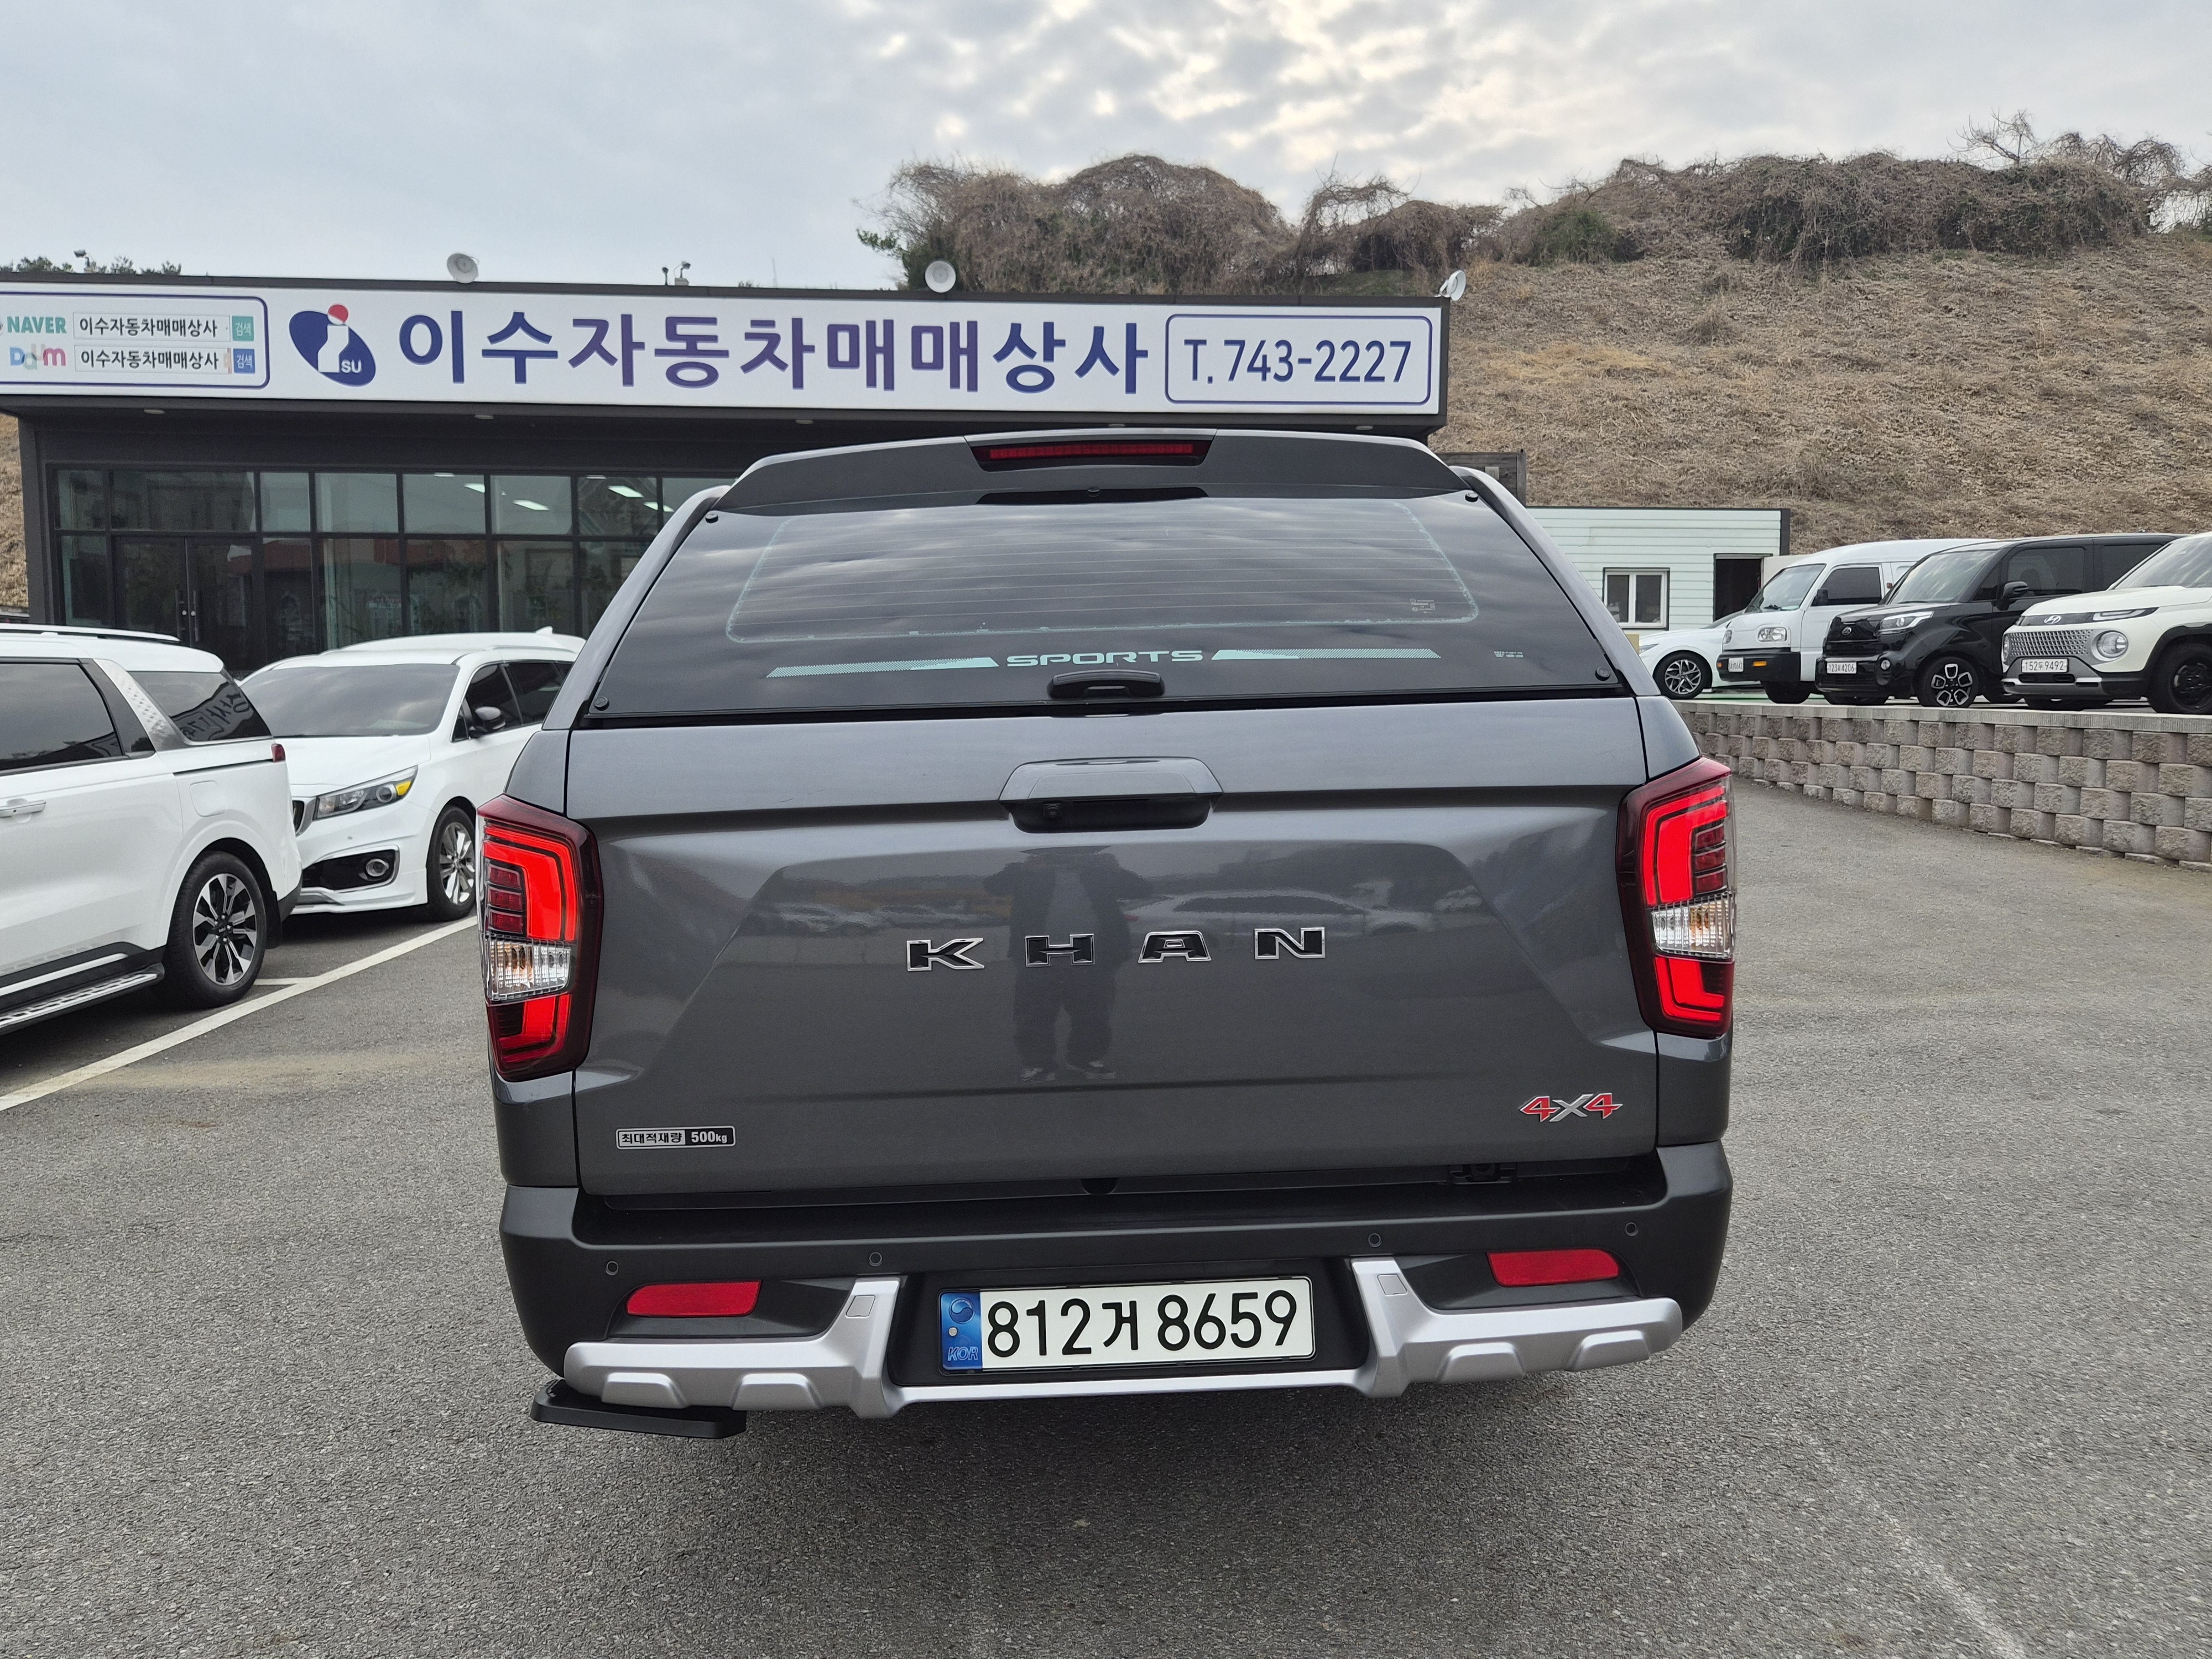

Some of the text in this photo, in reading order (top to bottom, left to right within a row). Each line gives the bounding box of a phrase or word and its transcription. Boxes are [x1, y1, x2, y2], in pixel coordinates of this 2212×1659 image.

[7, 316, 67, 334] NAVER
[80, 317, 252, 338] 이수자동차매매상사 검색
[9, 344, 66, 369] Daum
[81, 349, 253, 371] 이수자동차매매상사 검색
[399, 310, 1149, 394] 이수자동차매매상사
[341, 359, 362, 373] SU
[1006, 650, 1203, 667] SPORTS
[2044, 660, 2064, 670] 9492
[1841, 664, 1855, 672] 4206
[906, 927, 1327, 972] KHAN
[621, 1131, 728, 1145] 최대적재량 500kg
[987, 1289, 1297, 1359] 812거 8659
[947, 1346, 979, 1361] KOR
